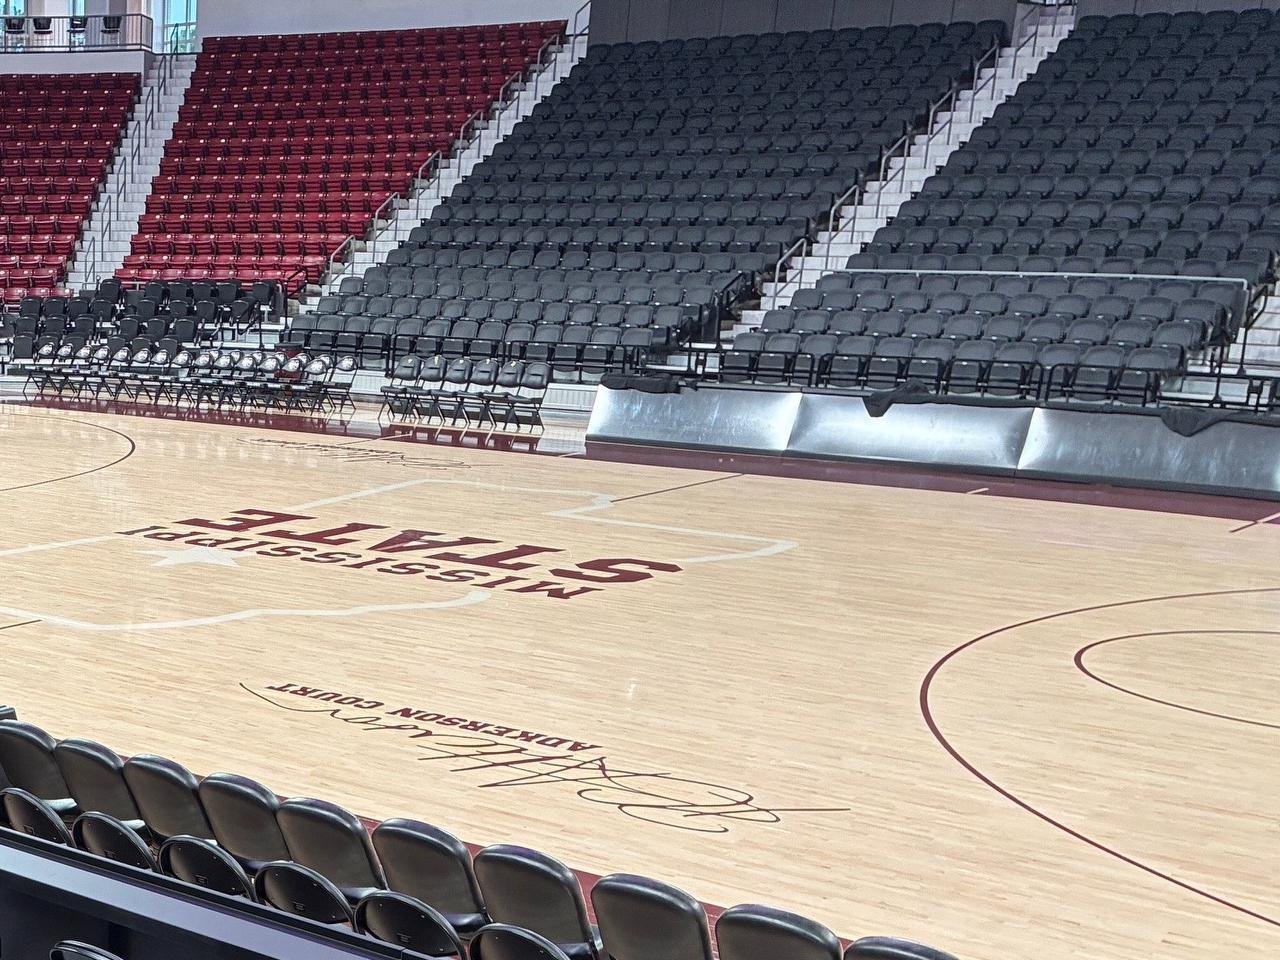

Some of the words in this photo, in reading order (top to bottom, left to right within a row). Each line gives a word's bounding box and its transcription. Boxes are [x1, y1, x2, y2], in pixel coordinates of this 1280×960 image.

[114, 525, 605, 600] MISSISSIPPI
[171, 508, 684, 584] STATE
[264, 683, 385, 709] COURT
[385, 706, 603, 752] ADKERSON
